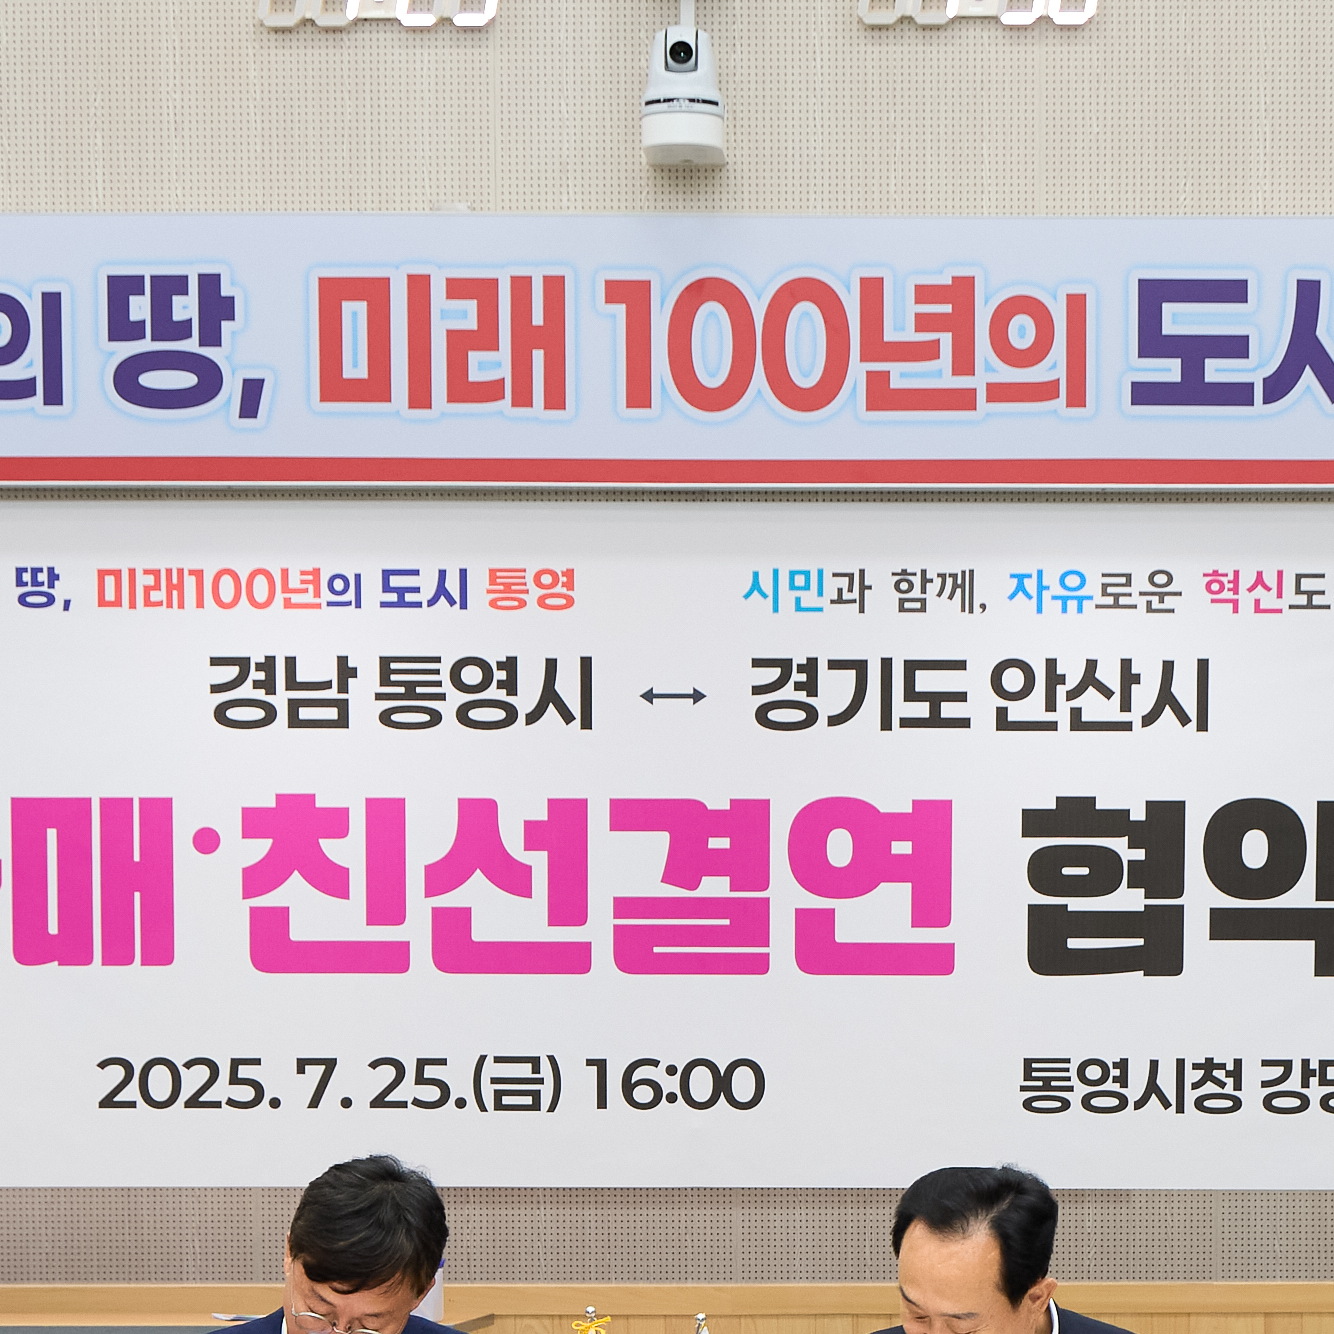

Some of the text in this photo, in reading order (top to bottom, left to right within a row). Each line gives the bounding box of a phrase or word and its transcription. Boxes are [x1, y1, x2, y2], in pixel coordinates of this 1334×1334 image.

[106, 272, 266, 420] 땅,
[318, 273, 567, 411] 미래
[604, 275, 1087, 412] 100년의
[14, 566, 72, 612] 땅,
[96, 567, 362, 610] 미래100년의
[379, 567, 468, 611] 도시
[485, 568, 575, 611] 통영
[742, 567, 873, 615] 시민과
[891, 568, 987, 615] 함께,
[1007, 568, 1183, 615] 자유로운
[209, 655, 593, 731] 경남 통영시
[750, 656, 1210, 733] 경기도 안산시
[95, 1056, 282, 1110] 2025.
[295, 1057, 353, 1110] 7.
[585, 1057, 766, 1111] 16:00
[1019, 1056, 1243, 1115] 통영시청
